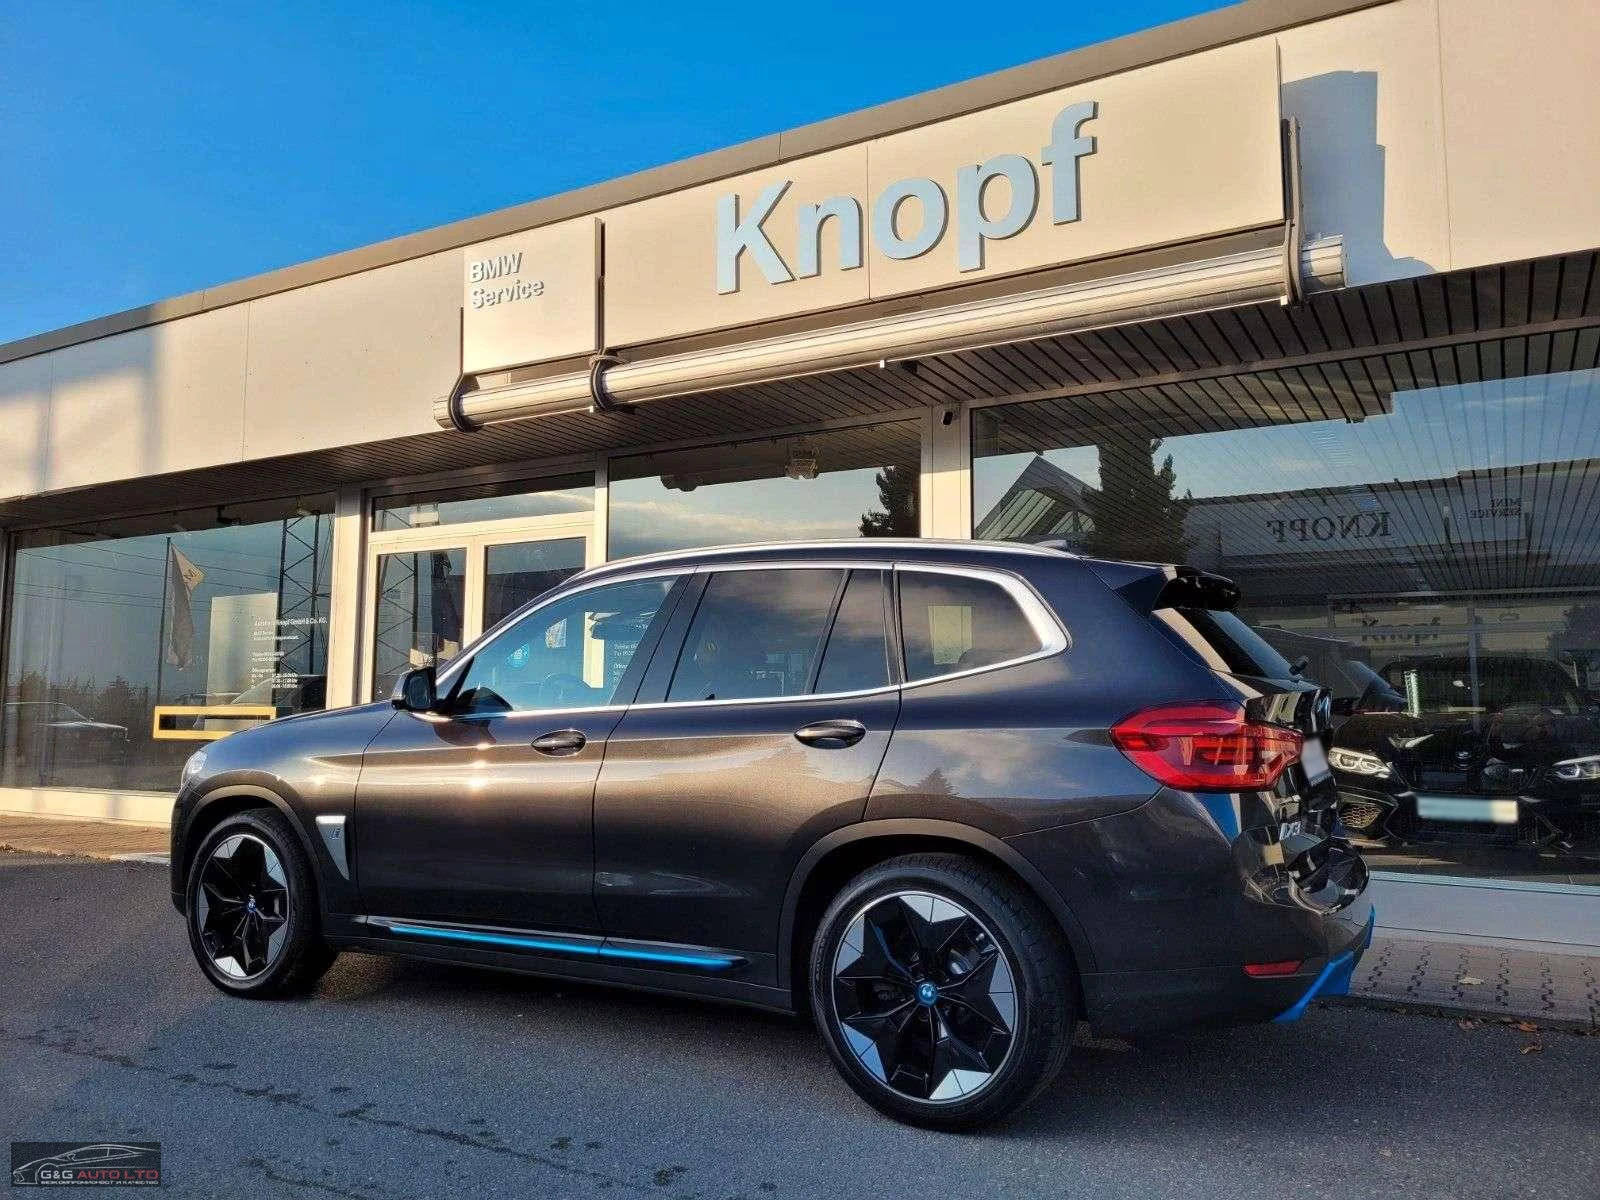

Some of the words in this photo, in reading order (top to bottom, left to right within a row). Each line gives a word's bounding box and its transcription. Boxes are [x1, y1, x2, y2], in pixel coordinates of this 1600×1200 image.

[715, 100, 1098, 296] Knopf
[469, 252, 522, 283] BMW
[471, 279, 545, 309] Service
